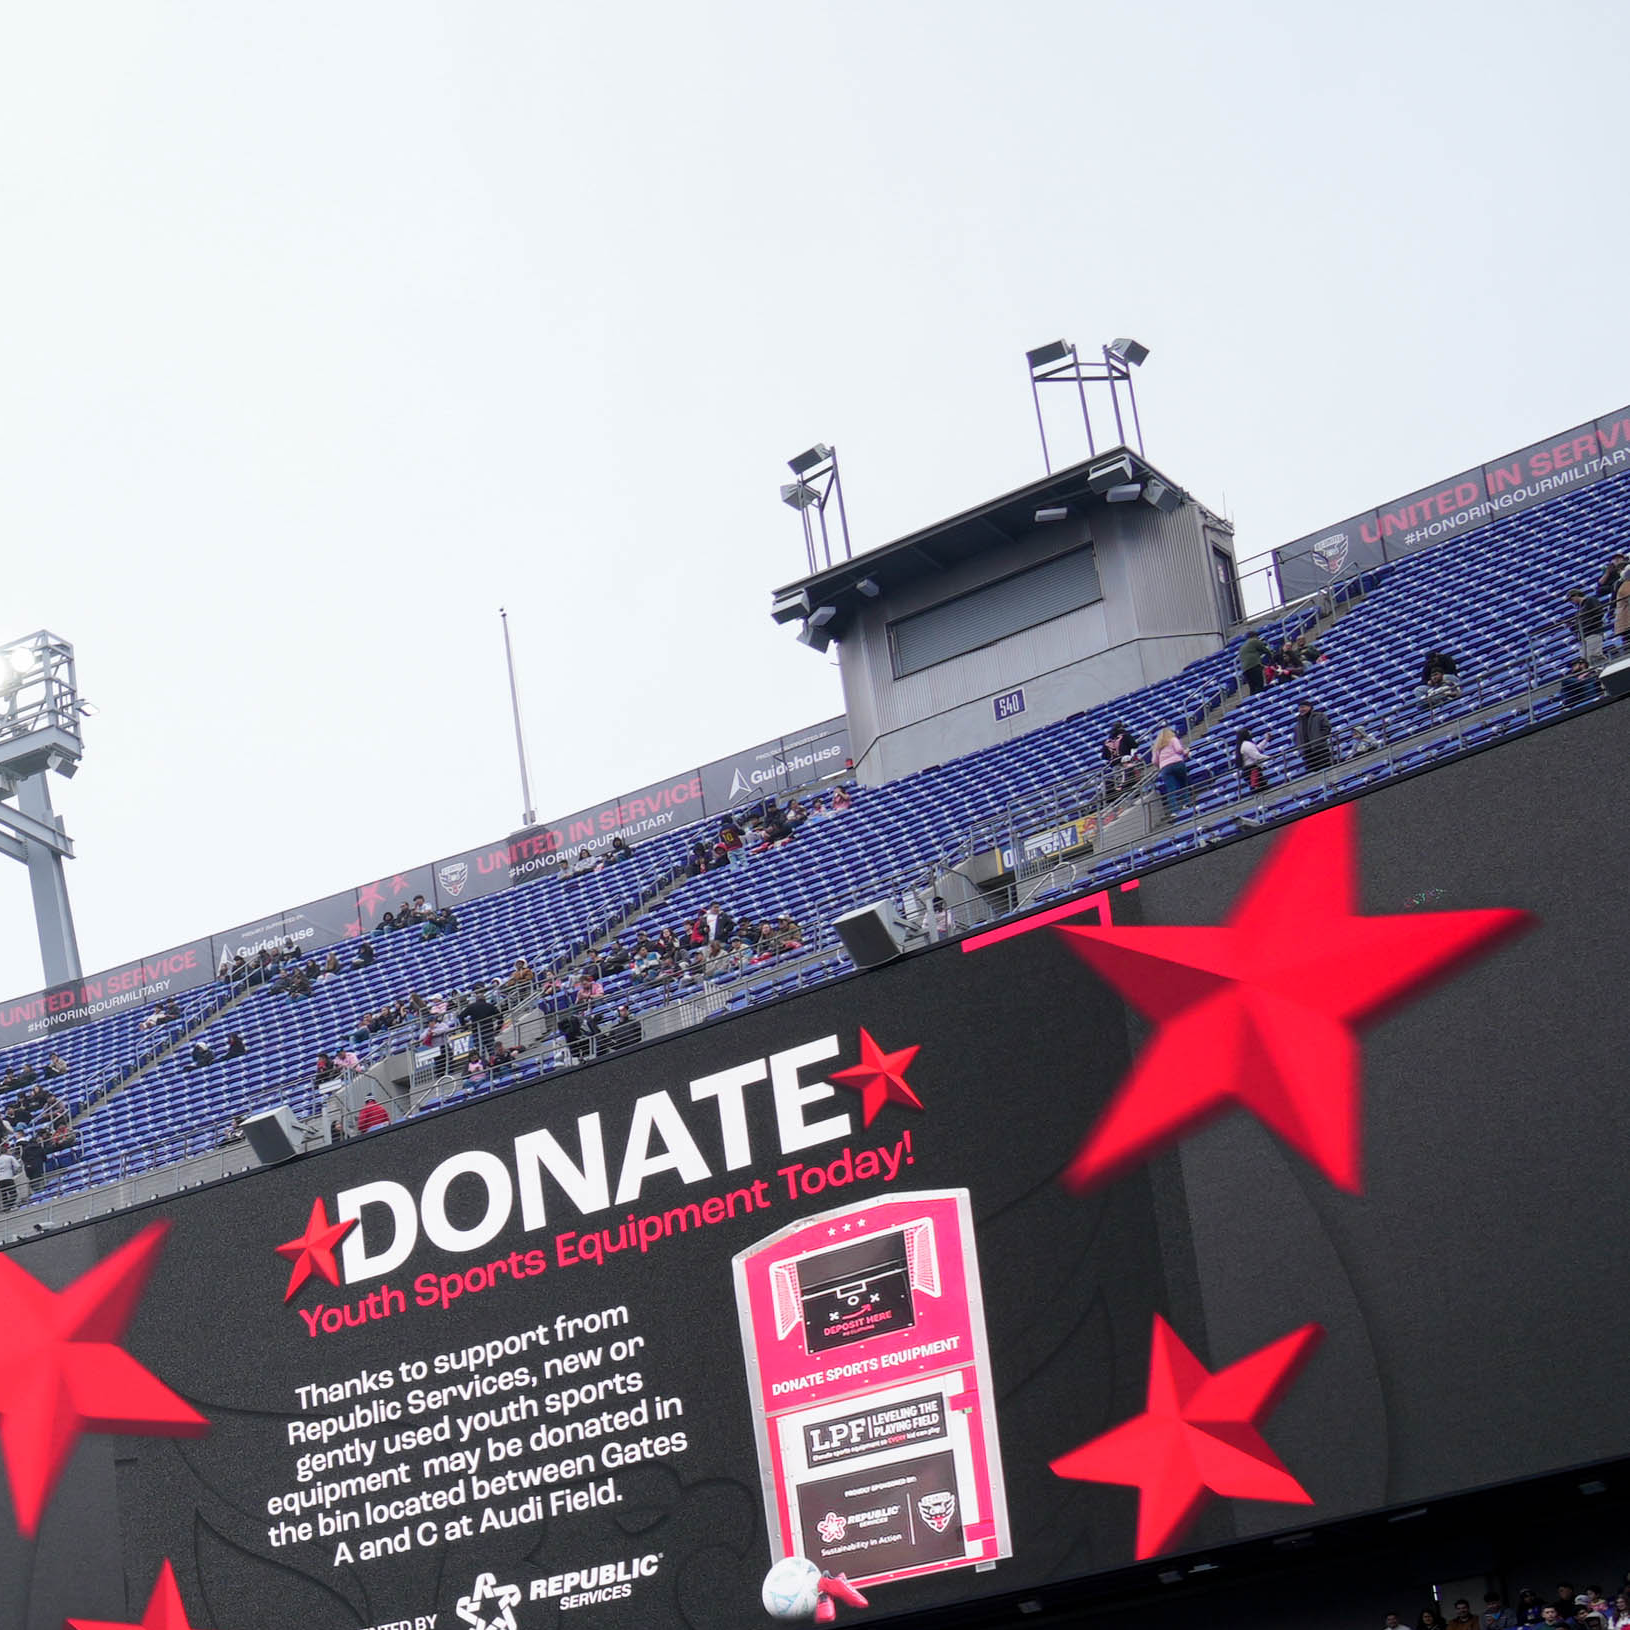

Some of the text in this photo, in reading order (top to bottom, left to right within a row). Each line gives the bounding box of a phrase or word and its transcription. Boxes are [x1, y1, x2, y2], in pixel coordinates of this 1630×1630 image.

[1359, 482, 1480, 544] UNITED
[1486, 463, 1524, 495] IN
[750, 743, 841, 785] Guidehouse
[477, 777, 704, 875] UNITED IN SERVICE
[507, 811, 674, 878] #HONORINGOURMILITARY
[237, 926, 315, 959] Guidehouse
[27, 979, 171, 1033] #HONORINGOURMILITARY
[82, 983, 103, 1005] IN
[108, 949, 197, 993] SERVICE
[336, 1034, 852, 1284] DONATE
[298, 1130, 914, 1337] Youth Sports Equipment Today!
[823, 1317, 865, 1336] DEPOSIT
[866, 1310, 893, 1325] HERE
[295, 1305, 629, 1411] Thanks to support from
[772, 1336, 960, 1396] DONATE SPORTS EQUIPMENT
[287, 1336, 645, 1445] Republic Services, new or
[873, 1400, 939, 1425] LEVELING THE
[295, 1371, 644, 1482] gently used youth sports
[810, 1417, 866, 1452] LPF
[874, 1413, 939, 1438] PLAYING FIELD
[267, 1396, 683, 1517] equipment may be donated in
[268, 1431, 688, 1548] the bin located between Gates
[848, 1506, 899, 1525] REPUBLIC
[333, 1477, 623, 1567] A and C at Audi Field.
[878, 1533, 903, 1544] Action
[529, 1553, 659, 1600] REPUBLIC
[559, 1583, 632, 1611] SERVICES
